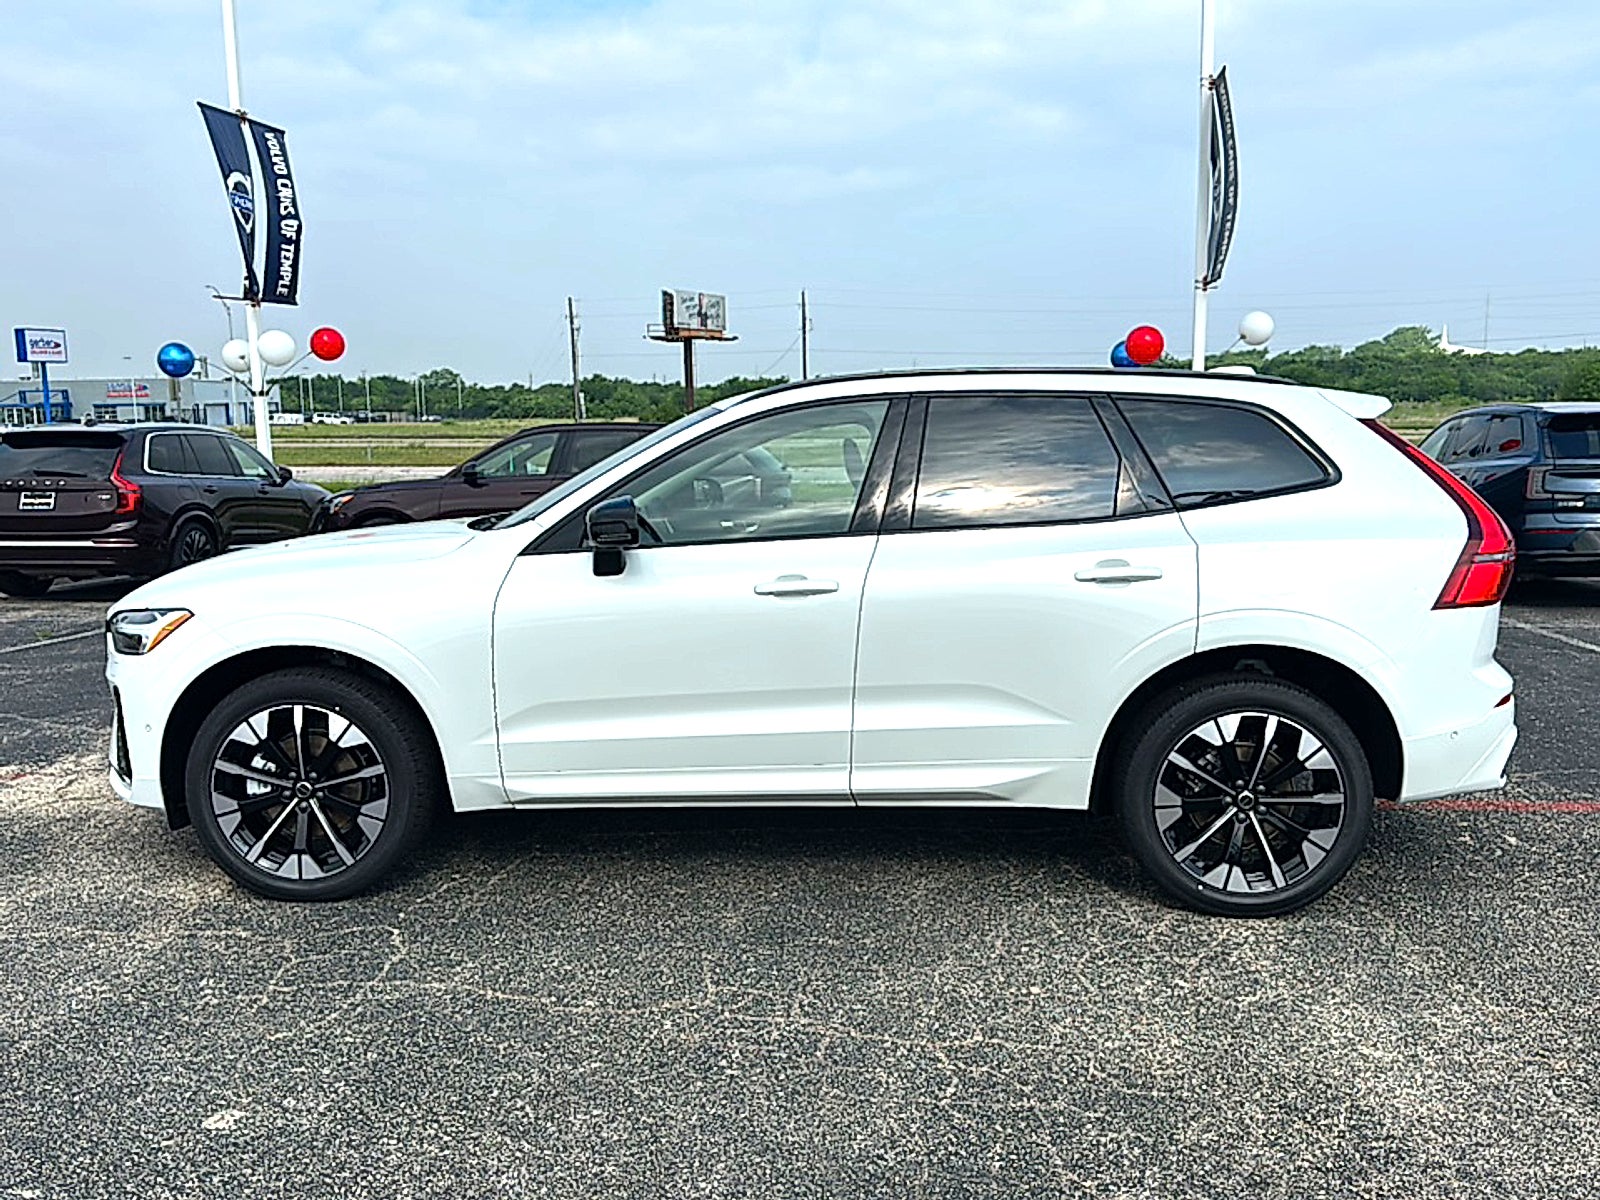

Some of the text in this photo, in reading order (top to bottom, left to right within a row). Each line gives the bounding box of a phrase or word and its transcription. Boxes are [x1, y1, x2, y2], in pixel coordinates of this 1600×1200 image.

[264, 131, 299, 297] VOLVO CARS OF TEMPLE
